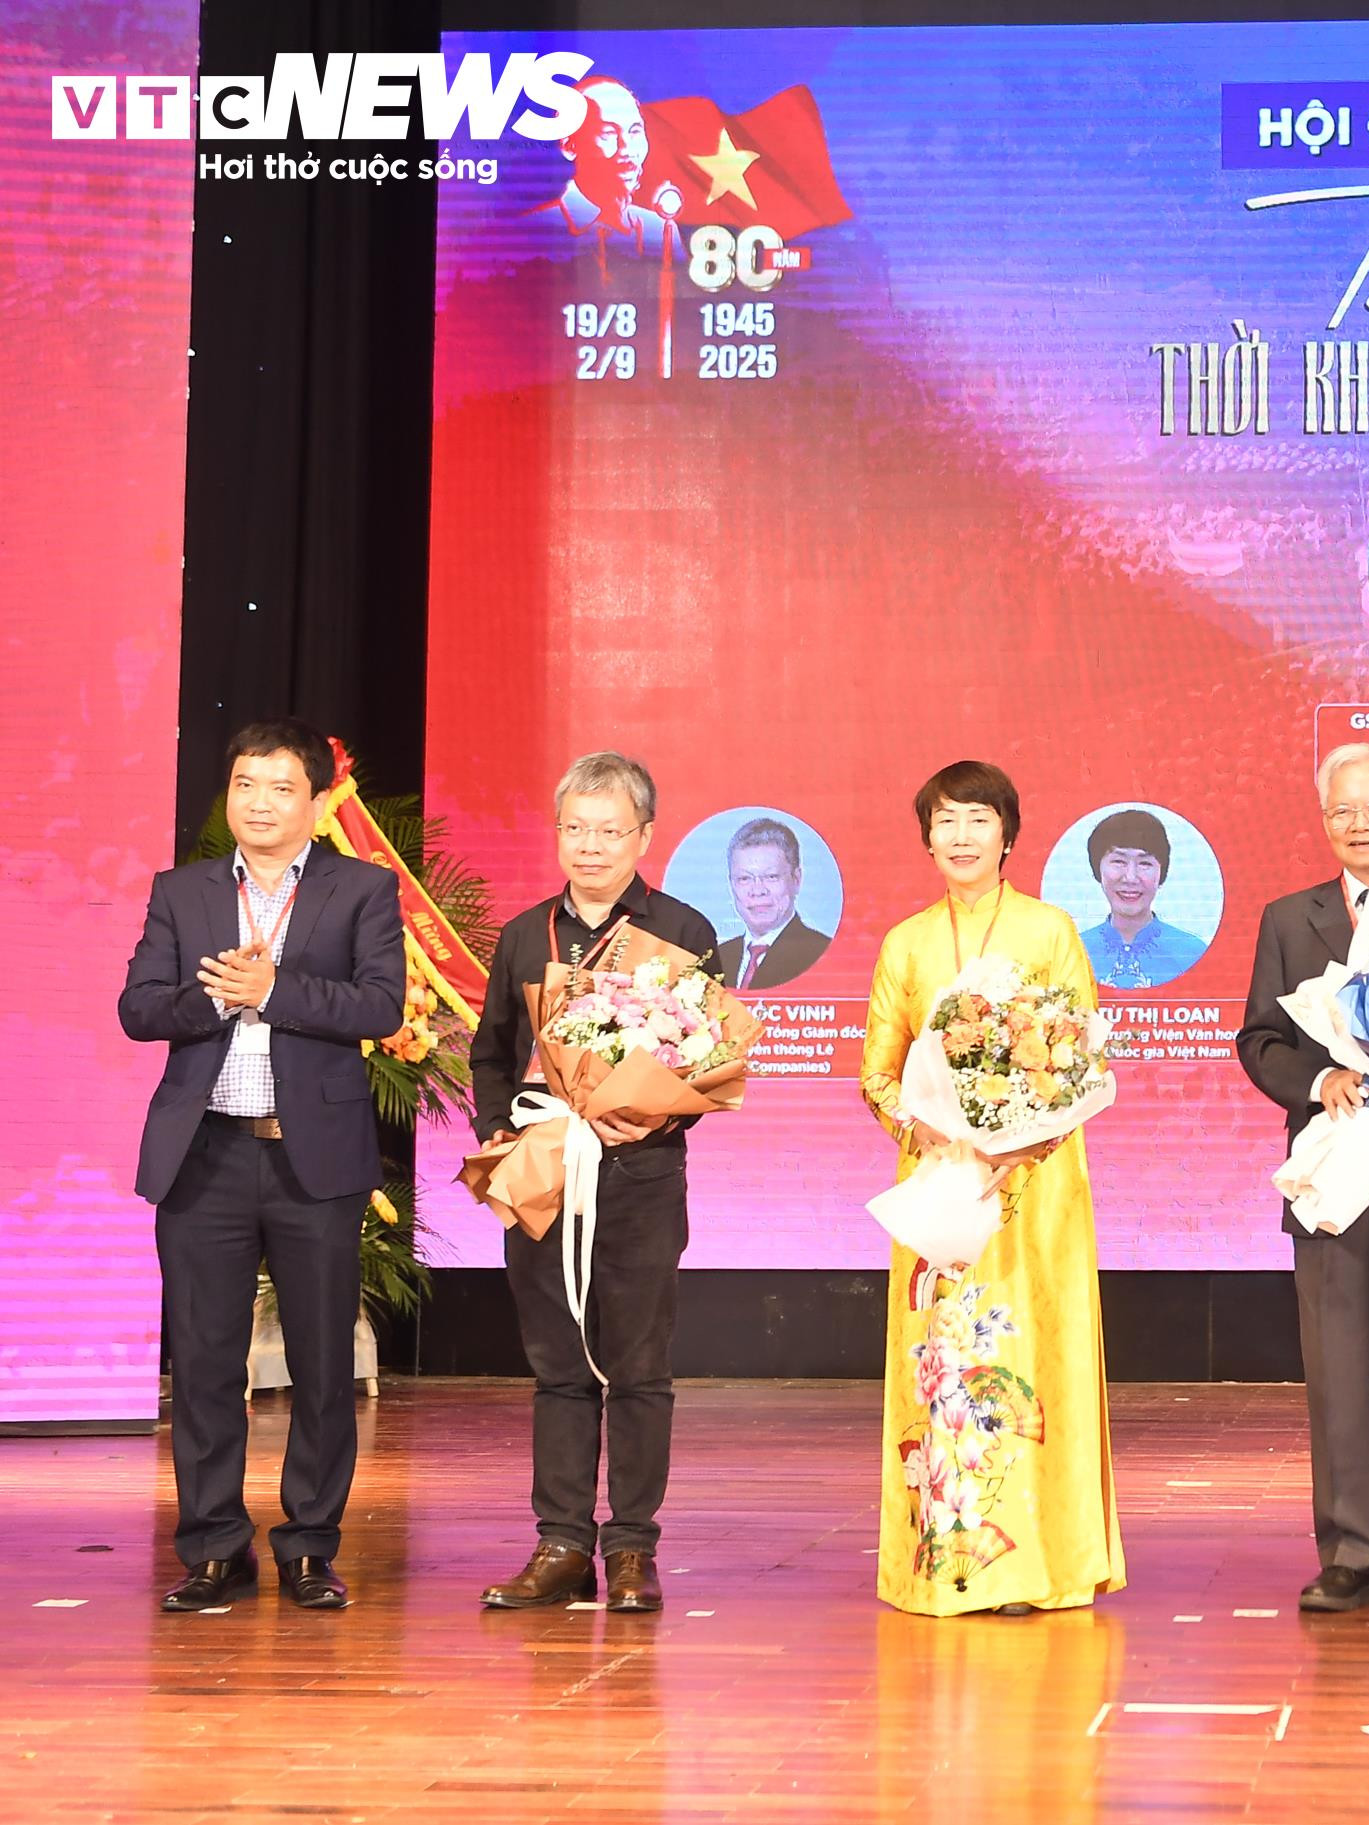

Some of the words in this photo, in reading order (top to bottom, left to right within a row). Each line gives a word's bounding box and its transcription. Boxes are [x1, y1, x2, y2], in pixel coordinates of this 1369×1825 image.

[1258, 99, 1351, 154] HỘI
[689, 225, 784, 291] 80
[563, 304, 637, 337] 19/8
[701, 303, 775, 337] 1945
[577, 346, 636, 380] 2/9
[699, 344, 778, 379] 2025
[1151, 319, 1270, 434] THỜI
[785, 1004, 836, 1022] VINH
[1125, 1006, 1159, 1028] THỊ
[1162, 1007, 1220, 1024] LOAN
[801, 1026, 839, 1039] Giám
[1152, 1028, 1185, 1043] Viện
[773, 1042, 815, 1057] thông
[1142, 1047, 1165, 1060] gia
[1167, 1046, 1196, 1060] Việt
[1197, 1046, 1231, 1058] Nam
